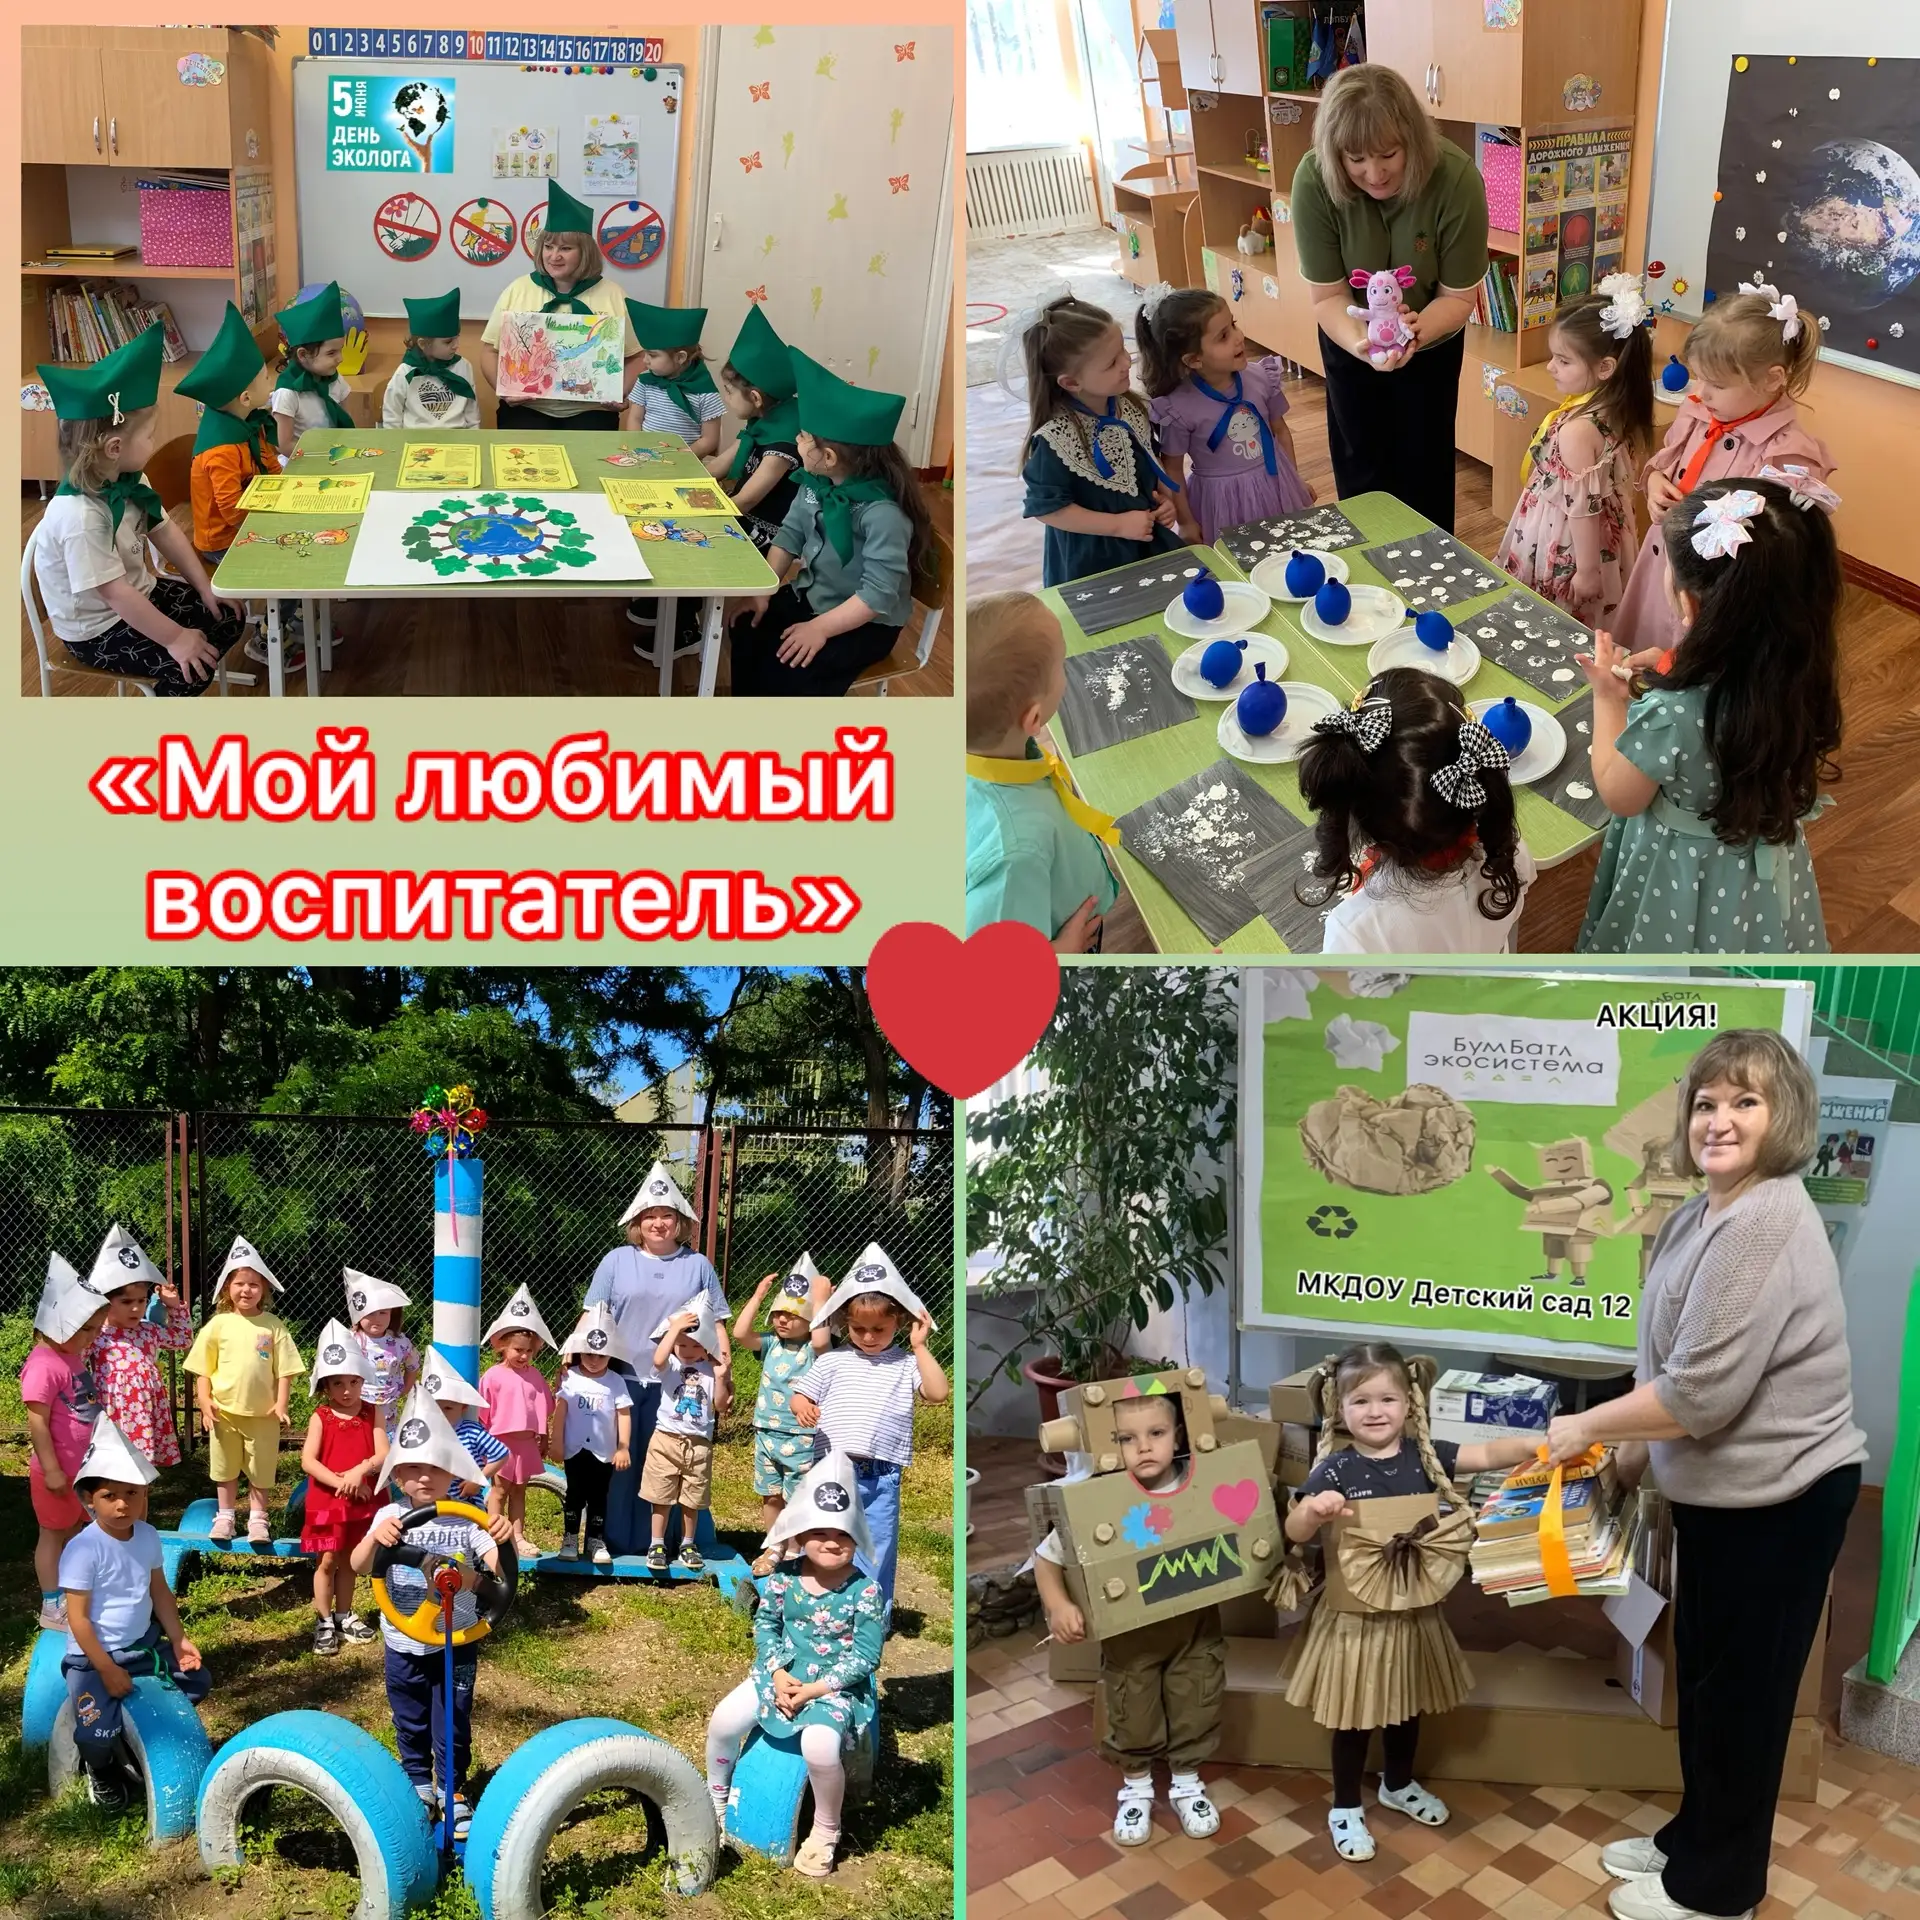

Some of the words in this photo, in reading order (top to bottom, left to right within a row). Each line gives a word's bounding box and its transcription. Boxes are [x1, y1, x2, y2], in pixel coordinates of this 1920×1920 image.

[312, 32, 322, 51] 0
[329, 32, 337, 51] 1
[344, 33, 353, 52] 2
[360, 33, 369, 52] 3
[376, 33, 385, 53] 4
[392, 34, 400, 53] 5
[407, 34, 417, 53] 6
[424, 34, 433, 54] 7
[440, 35, 449, 54] 8
[455, 35, 464, 54] 9
[470, 36, 484, 55] 10
[487, 36, 500, 56] 11
[505, 37, 519, 56] 12
[522, 38, 536, 57] 13
[540, 39, 555, 59] 14
[558, 40, 572, 59] 15
[575, 41, 590, 60] 16
[593, 41, 608, 61] 17
[611, 42, 626, 61] 18
[628, 43, 643, 62] 19
[645, 43, 662, 62] 20
[333, 81, 353, 117] 5
[355, 81, 367, 117] ИЮНЯ
[332, 126, 380, 146] ДЕНЬ
[1555, 130, 1607, 148] ПРАВИЛА
[332, 148, 412, 168] ЭКОЛОГА
[1528, 147, 1584, 163] ДОРОЖНОГО
[1585, 141, 1630, 157] ДВИЖЕНИЯ
[1424, 1054, 1603, 1074] экосистема
[1820, 1101, 1887, 1122] ИЖЕНИЯ
[403, 1530, 470, 1548] ARADISE
